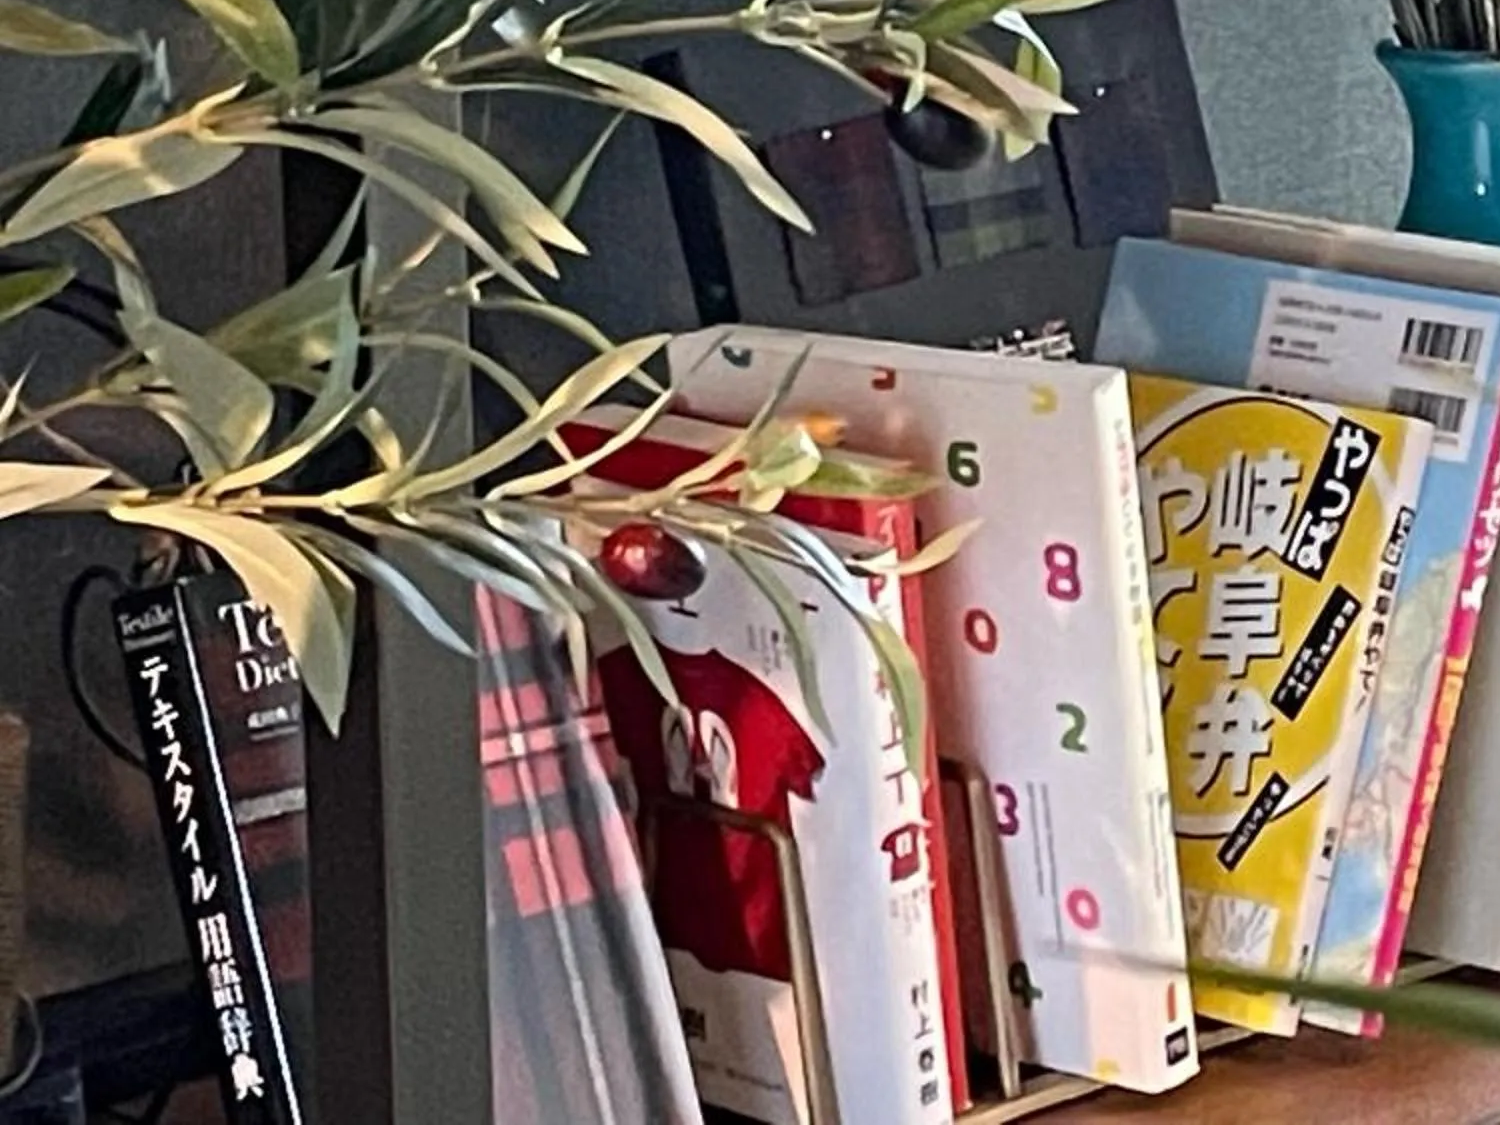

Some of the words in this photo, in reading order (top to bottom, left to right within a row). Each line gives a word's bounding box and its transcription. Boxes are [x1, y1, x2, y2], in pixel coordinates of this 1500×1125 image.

[946, 441, 981, 488] 6
[1286, 426, 1372, 572] やっぱ
[1043, 542, 1082, 602] 8
[1055, 702, 1088, 753] 2
[140, 656, 265, 1102] テキスタイル用語辞典
